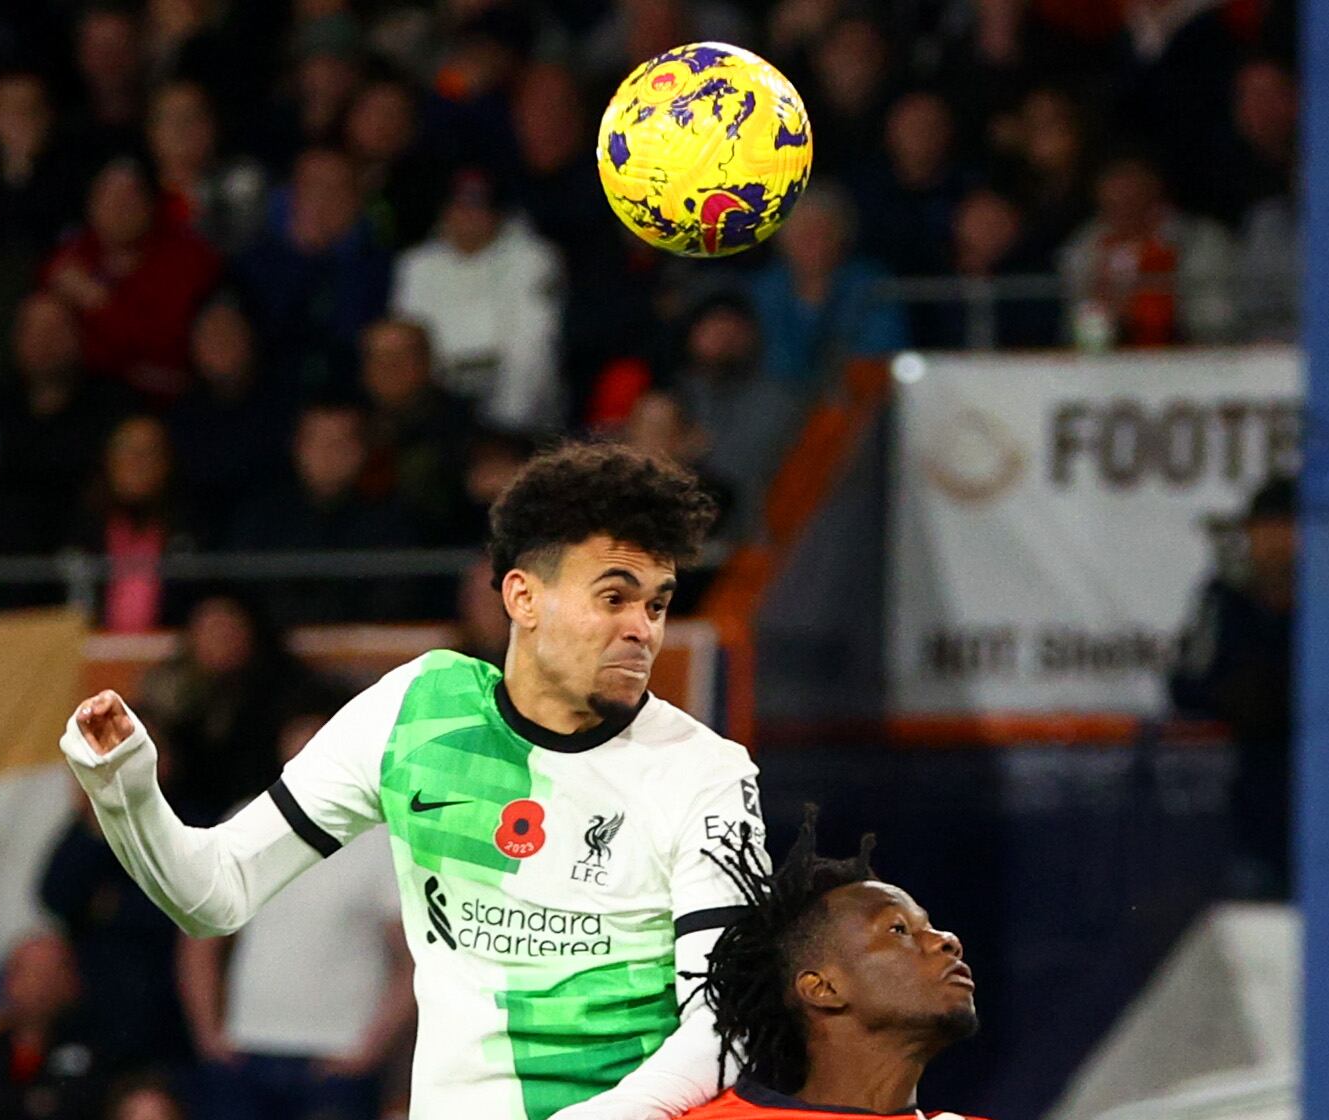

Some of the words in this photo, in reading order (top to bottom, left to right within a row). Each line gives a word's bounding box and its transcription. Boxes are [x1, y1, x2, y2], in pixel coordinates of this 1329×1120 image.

[504, 840, 535, 854] 2023
[461, 898, 602, 935] standard
[458, 926, 612, 957] chartered
